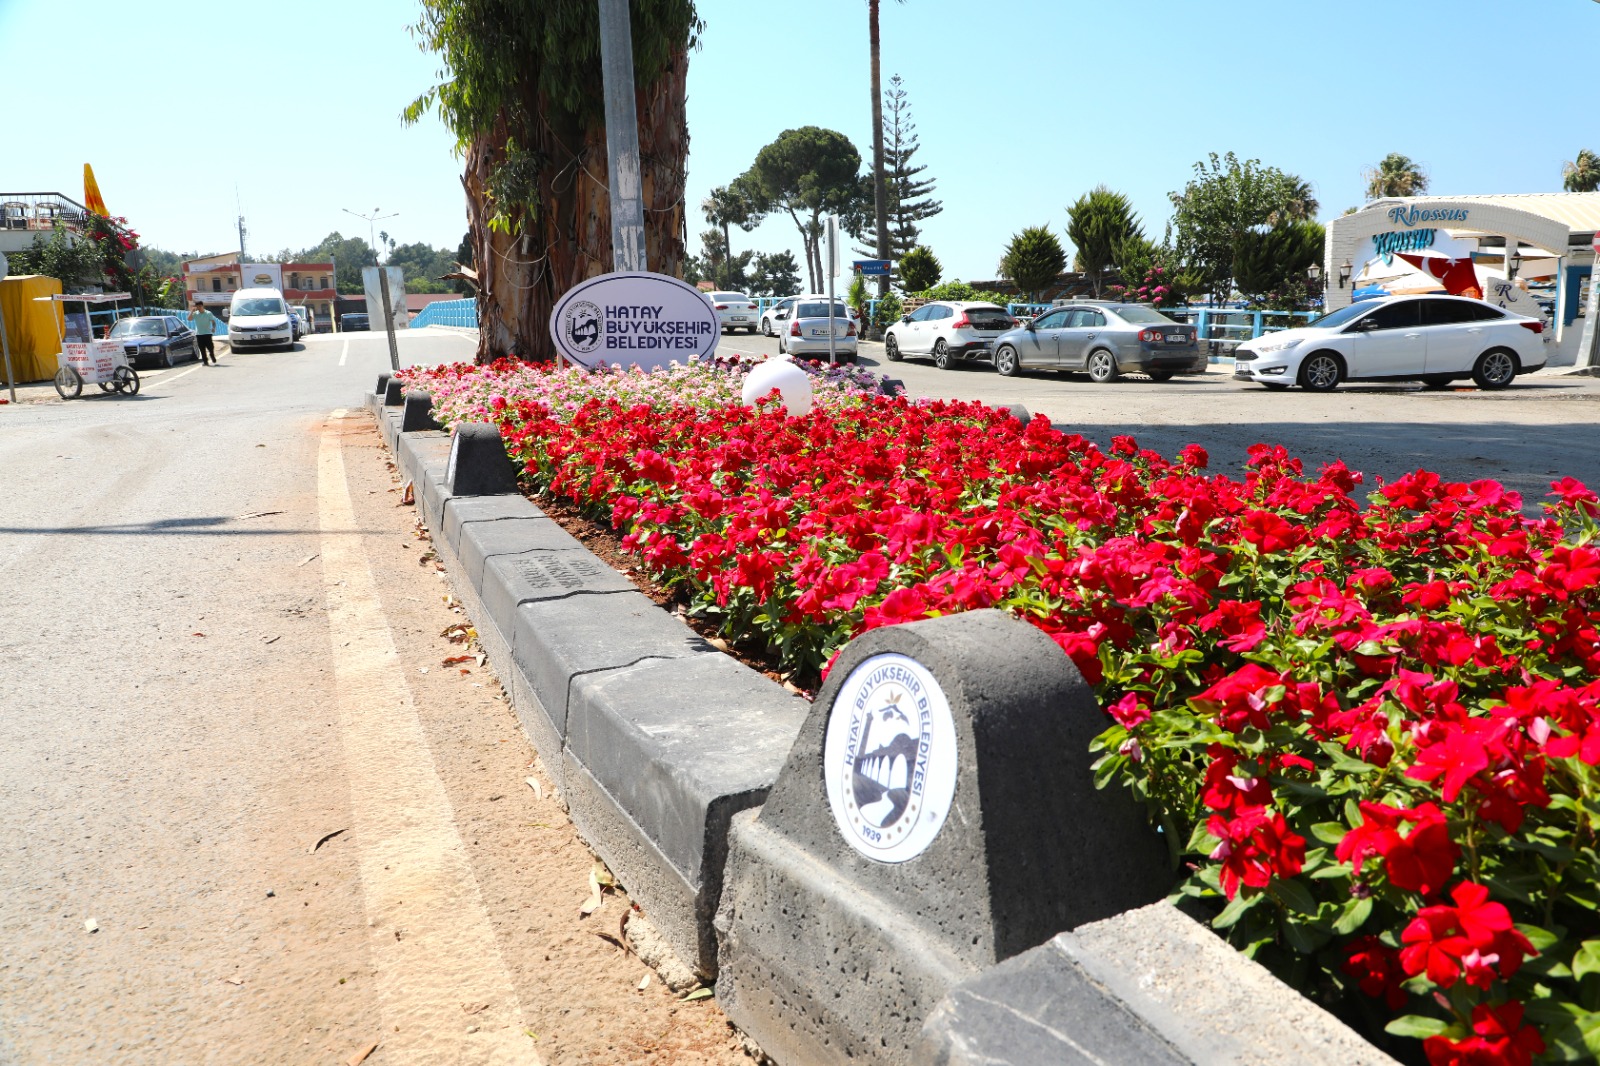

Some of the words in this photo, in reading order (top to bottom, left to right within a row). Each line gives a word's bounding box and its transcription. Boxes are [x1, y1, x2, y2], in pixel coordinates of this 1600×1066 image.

[1387, 204, 1469, 227] Rhossus
[606, 305, 664, 319] HATAY
[606, 321, 712, 335] BÜYÜKŞEHİR
[606, 336, 698, 349] BELEDİYESİ
[845, 714, 861, 766] HATAY
[862, 824, 882, 843] 1939
